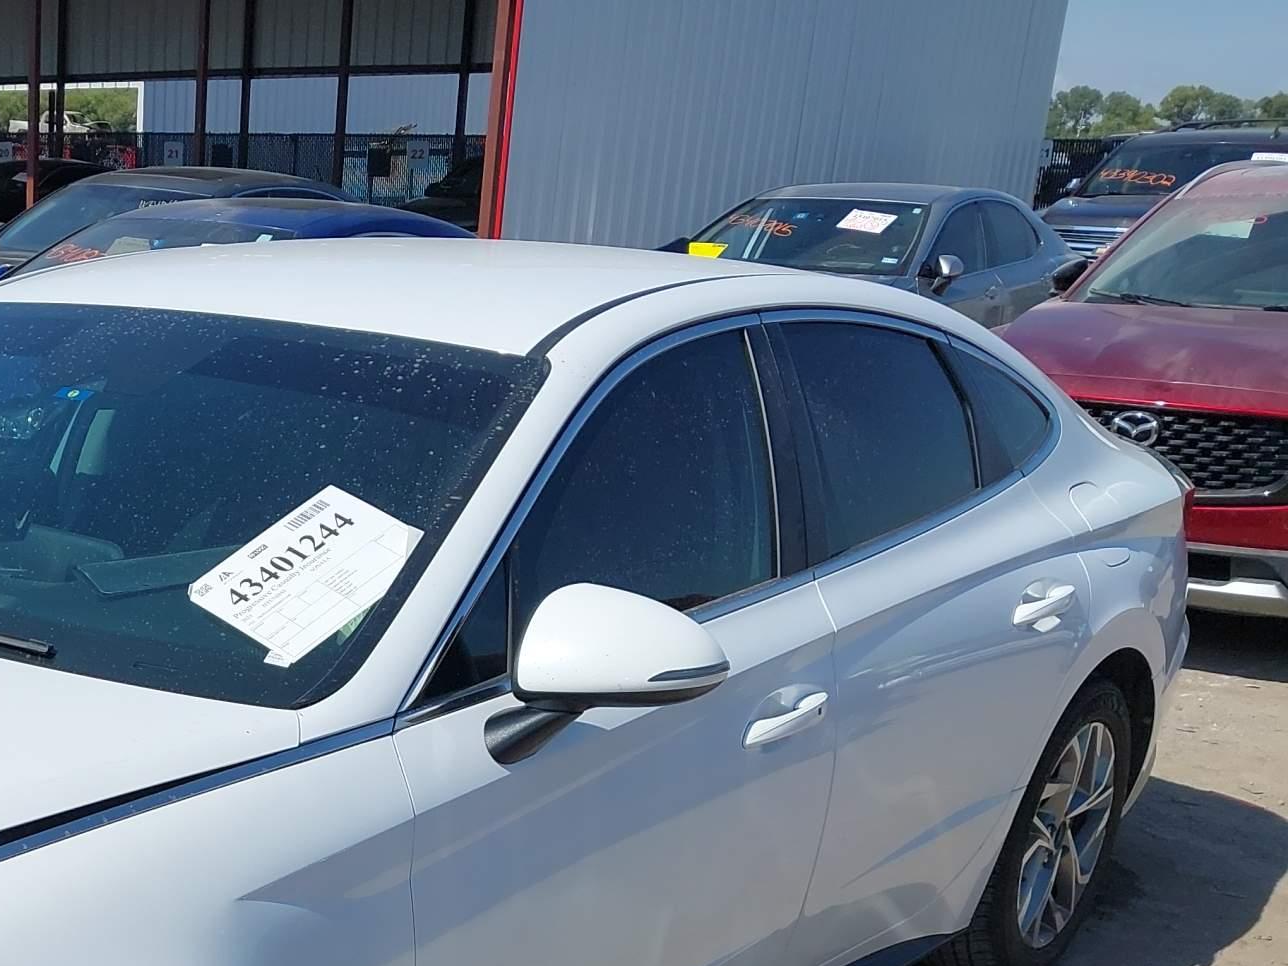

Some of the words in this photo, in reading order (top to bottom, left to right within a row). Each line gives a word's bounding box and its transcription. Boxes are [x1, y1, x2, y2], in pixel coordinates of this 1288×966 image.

[167, 148, 179, 159] 21
[410, 149, 425, 160] 22
[229, 511, 355, 607] 43401244
[232, 590, 272, 620] Progressive
[269, 568, 301, 592] Casualty
